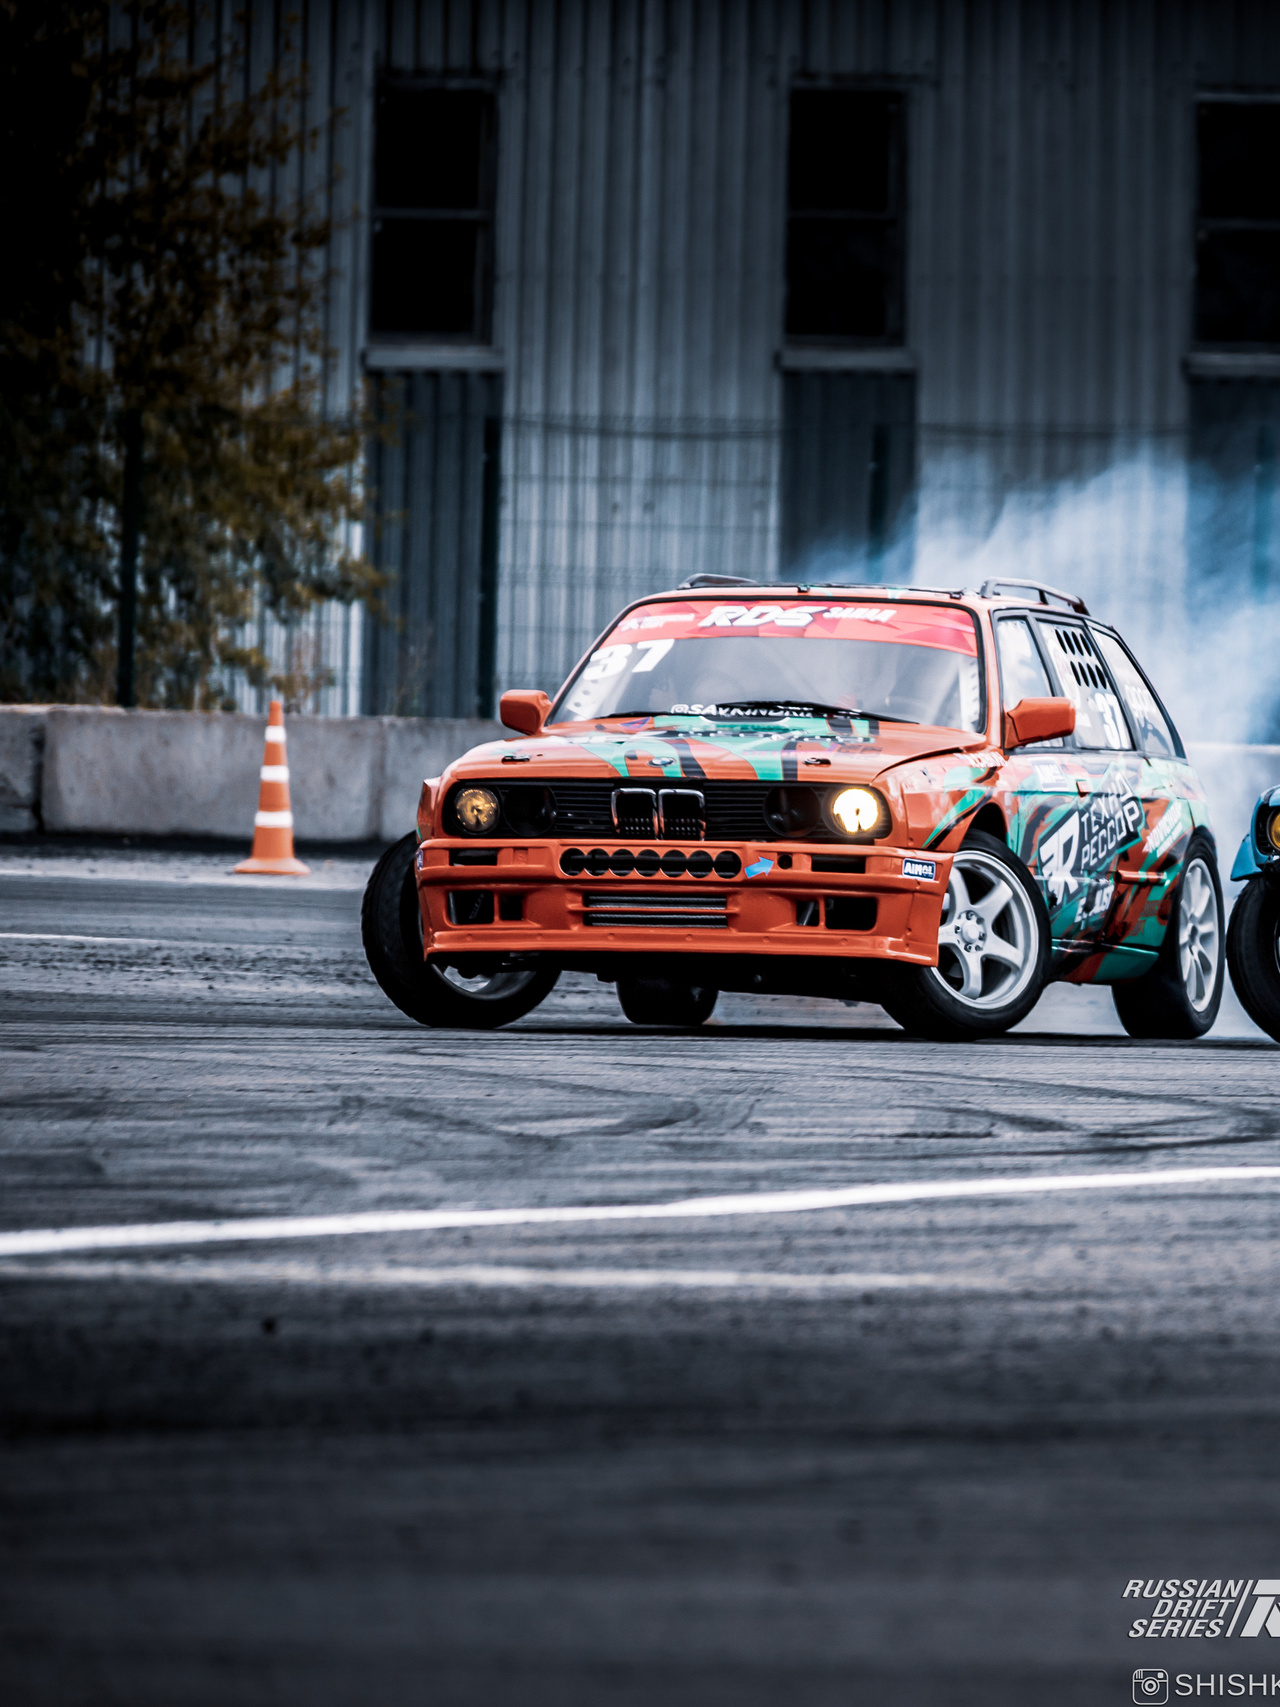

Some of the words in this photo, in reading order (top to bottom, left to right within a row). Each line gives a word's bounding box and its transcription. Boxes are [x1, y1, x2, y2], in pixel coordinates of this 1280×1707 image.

[698, 605, 828, 627] RDS
[583, 638, 675, 681] 37
[1094, 692, 1131, 750] 37
[1080, 771, 1134, 841] ТЕХНО
[1080, 800, 1140, 875] РЕССОР
[903, 862, 934, 876] AIMOL
